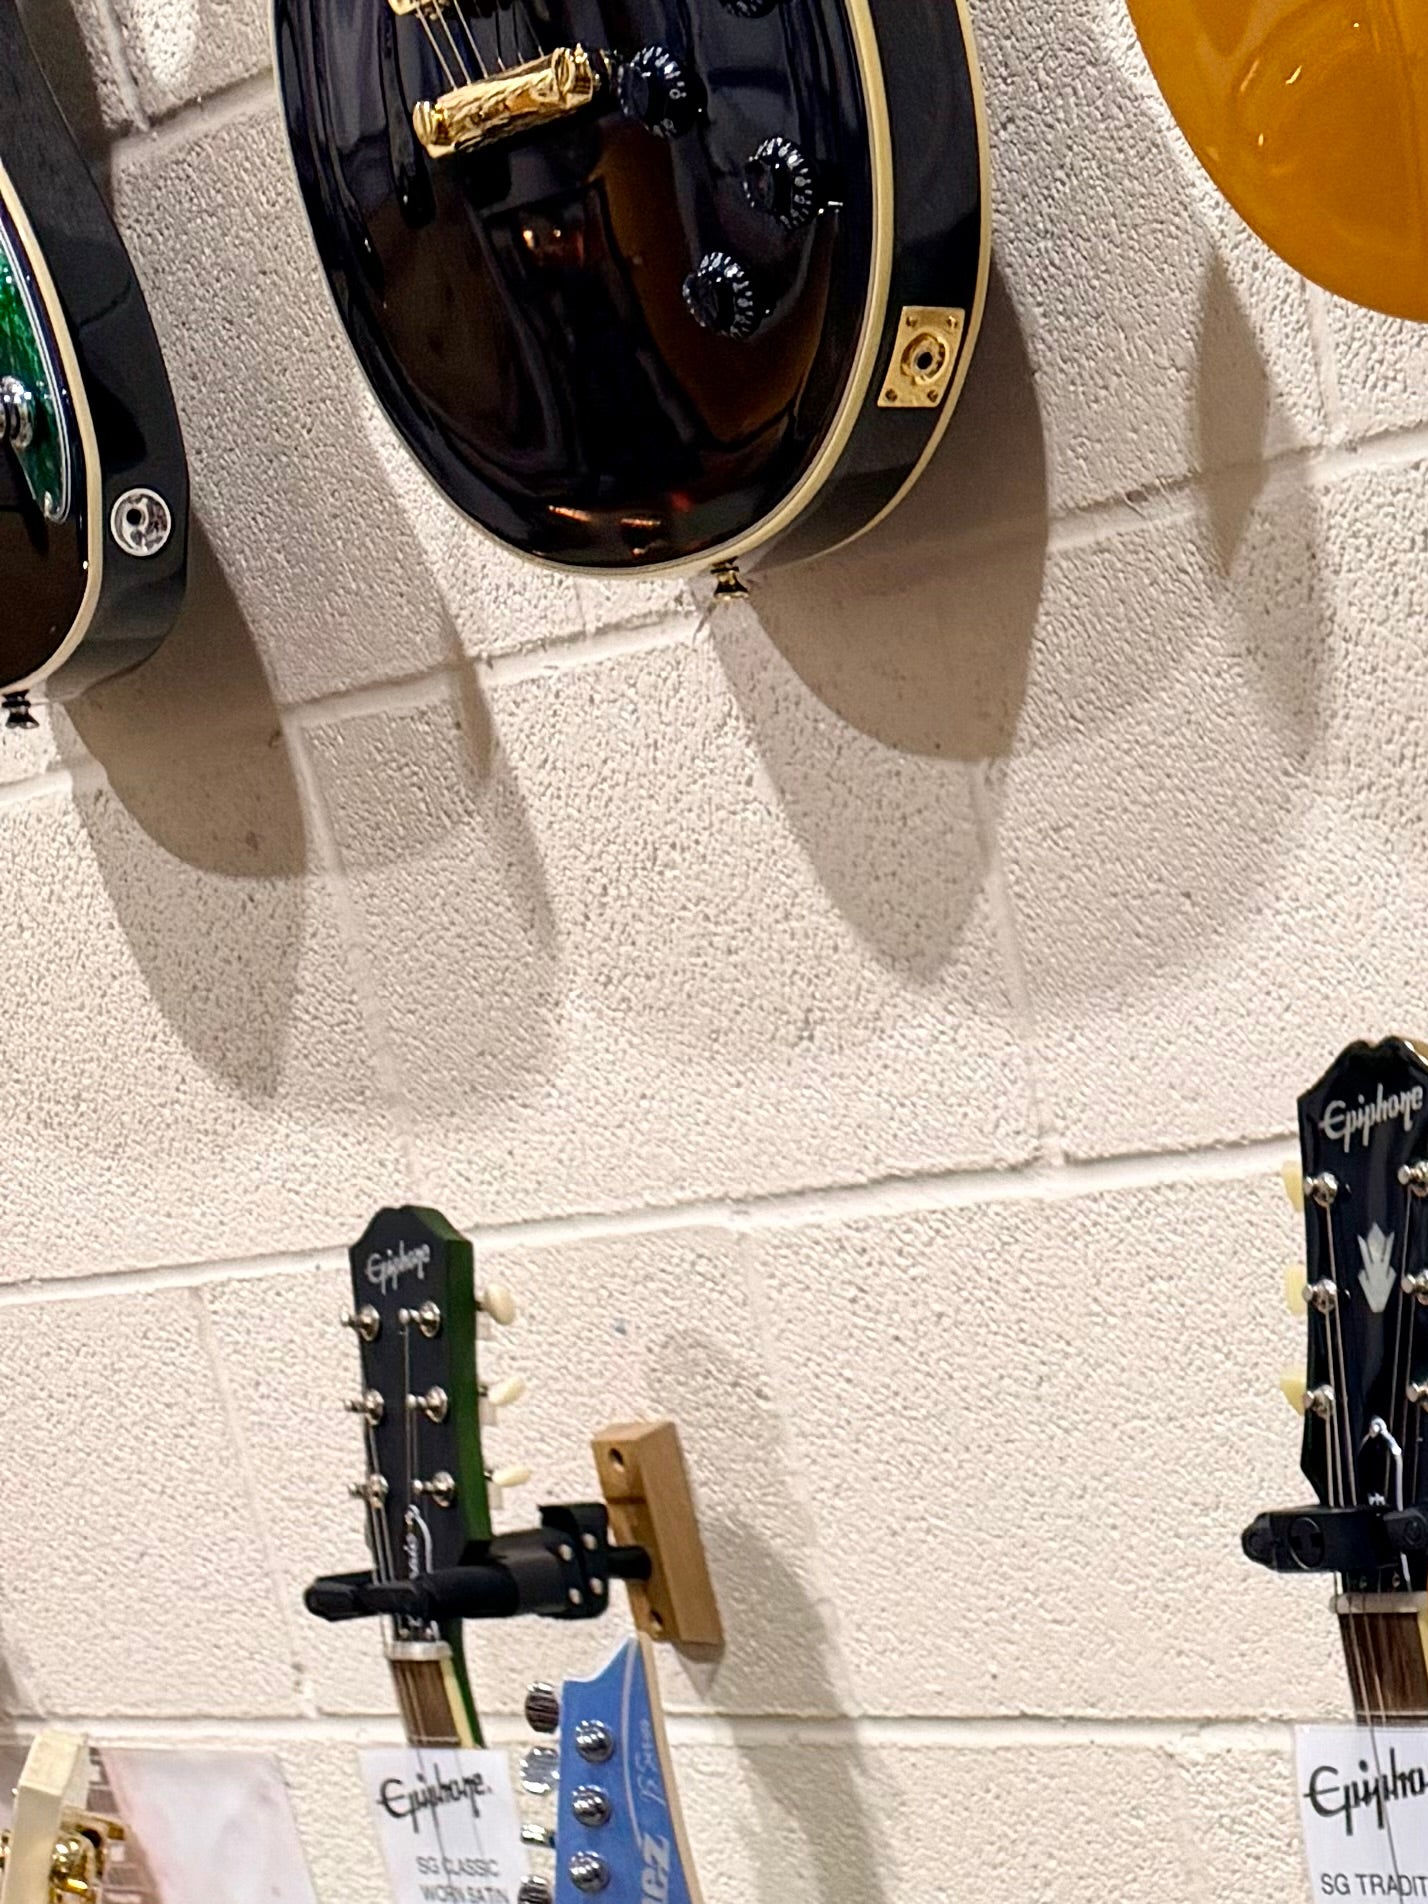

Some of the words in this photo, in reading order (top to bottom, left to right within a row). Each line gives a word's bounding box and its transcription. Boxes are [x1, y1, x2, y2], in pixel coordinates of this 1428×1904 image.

[1319, 1083, 1423, 1153] Epiphone
[365, 1240, 431, 1294] Epiphone
[377, 1763, 486, 1834] Epiphone
[416, 1855, 440, 1875] SG
[1320, 1873, 1350, 1896] SG
